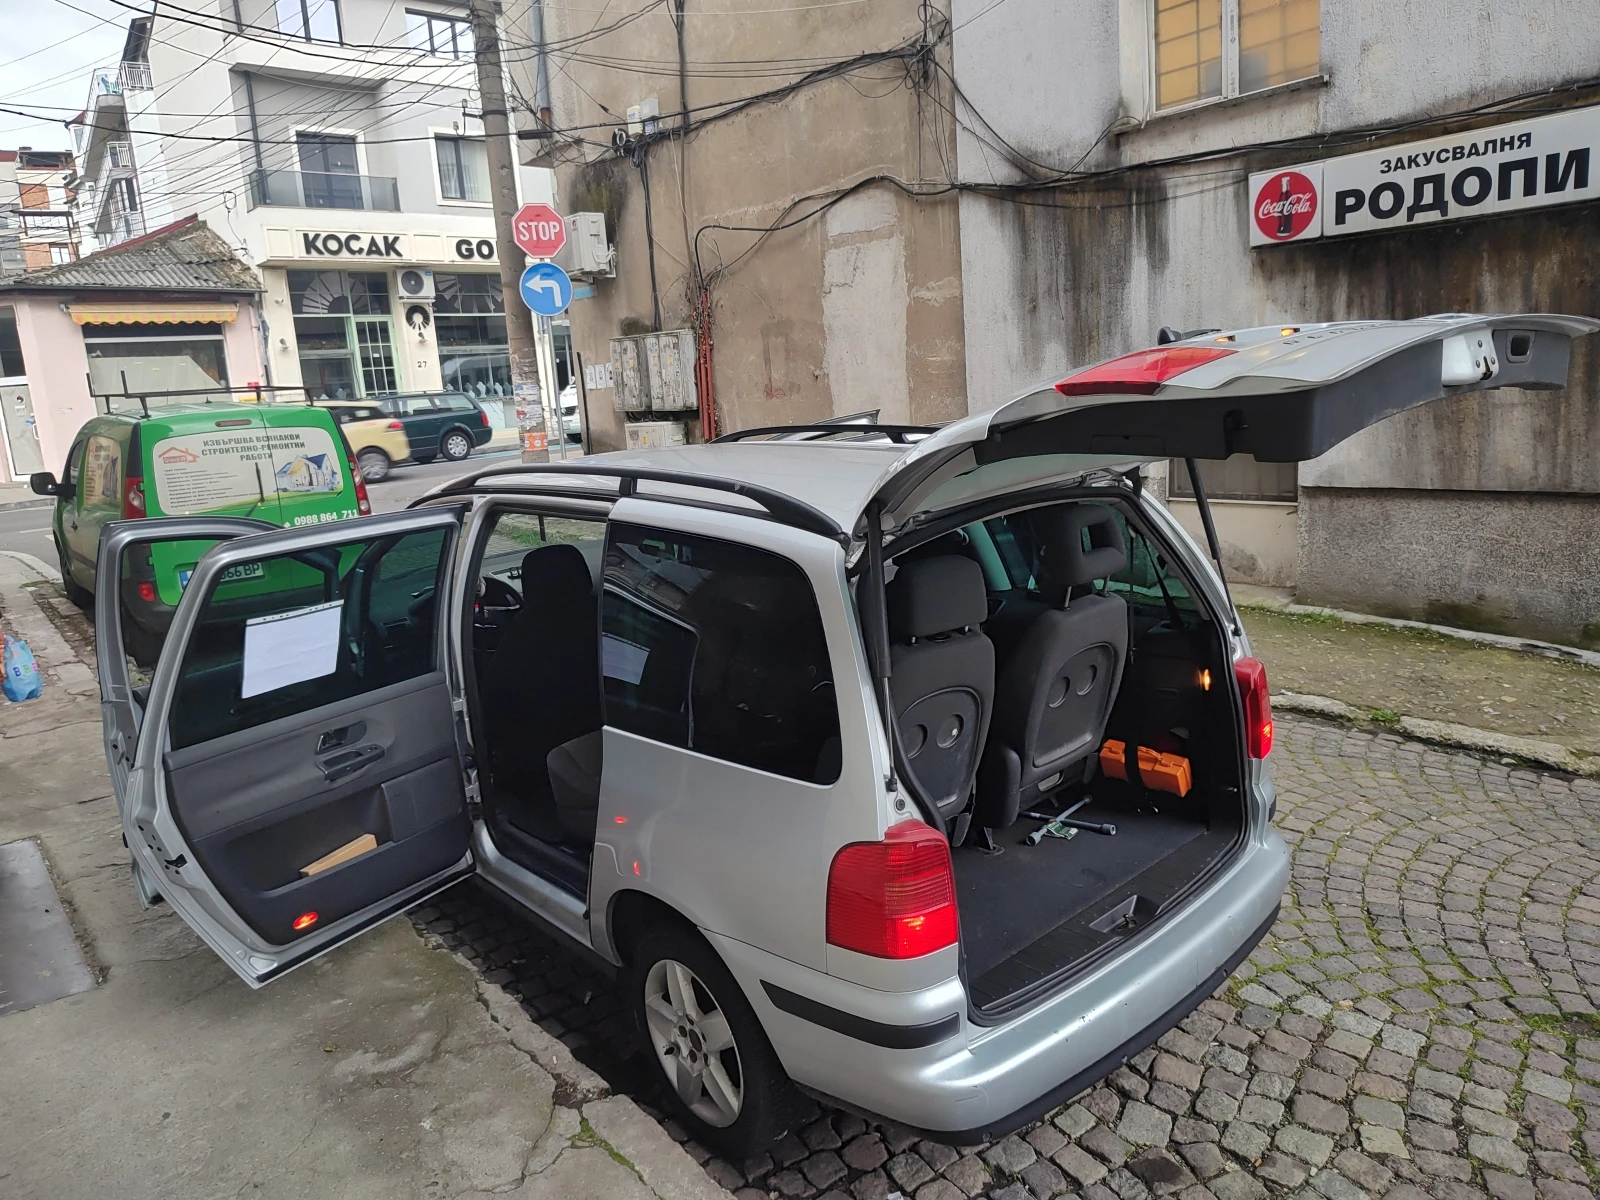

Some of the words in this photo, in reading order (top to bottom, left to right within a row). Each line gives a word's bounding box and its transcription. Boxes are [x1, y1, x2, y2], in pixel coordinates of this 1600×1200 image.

[1380, 132, 1532, 174] ЗАКУСВАЛНЯ
[1335, 147, 1591, 226] РОДОПИ
[1258, 193, 1313, 219] Coca-Cola
[518, 221, 560, 241] STOP
[455, 239, 499, 259] GO
[201, 442, 305, 456] СТРОИТЕЛНО-РЕМОНТНИ
[203, 436, 254, 447] ИЗВЪРШВА
[256, 433, 300, 443] ВСЯКАКВИ
[240, 453, 272, 461] РАБОТИ
[294, 515, 318, 525] 0988
[320, 512, 337, 522] 864
[341, 509, 358, 519] 711
